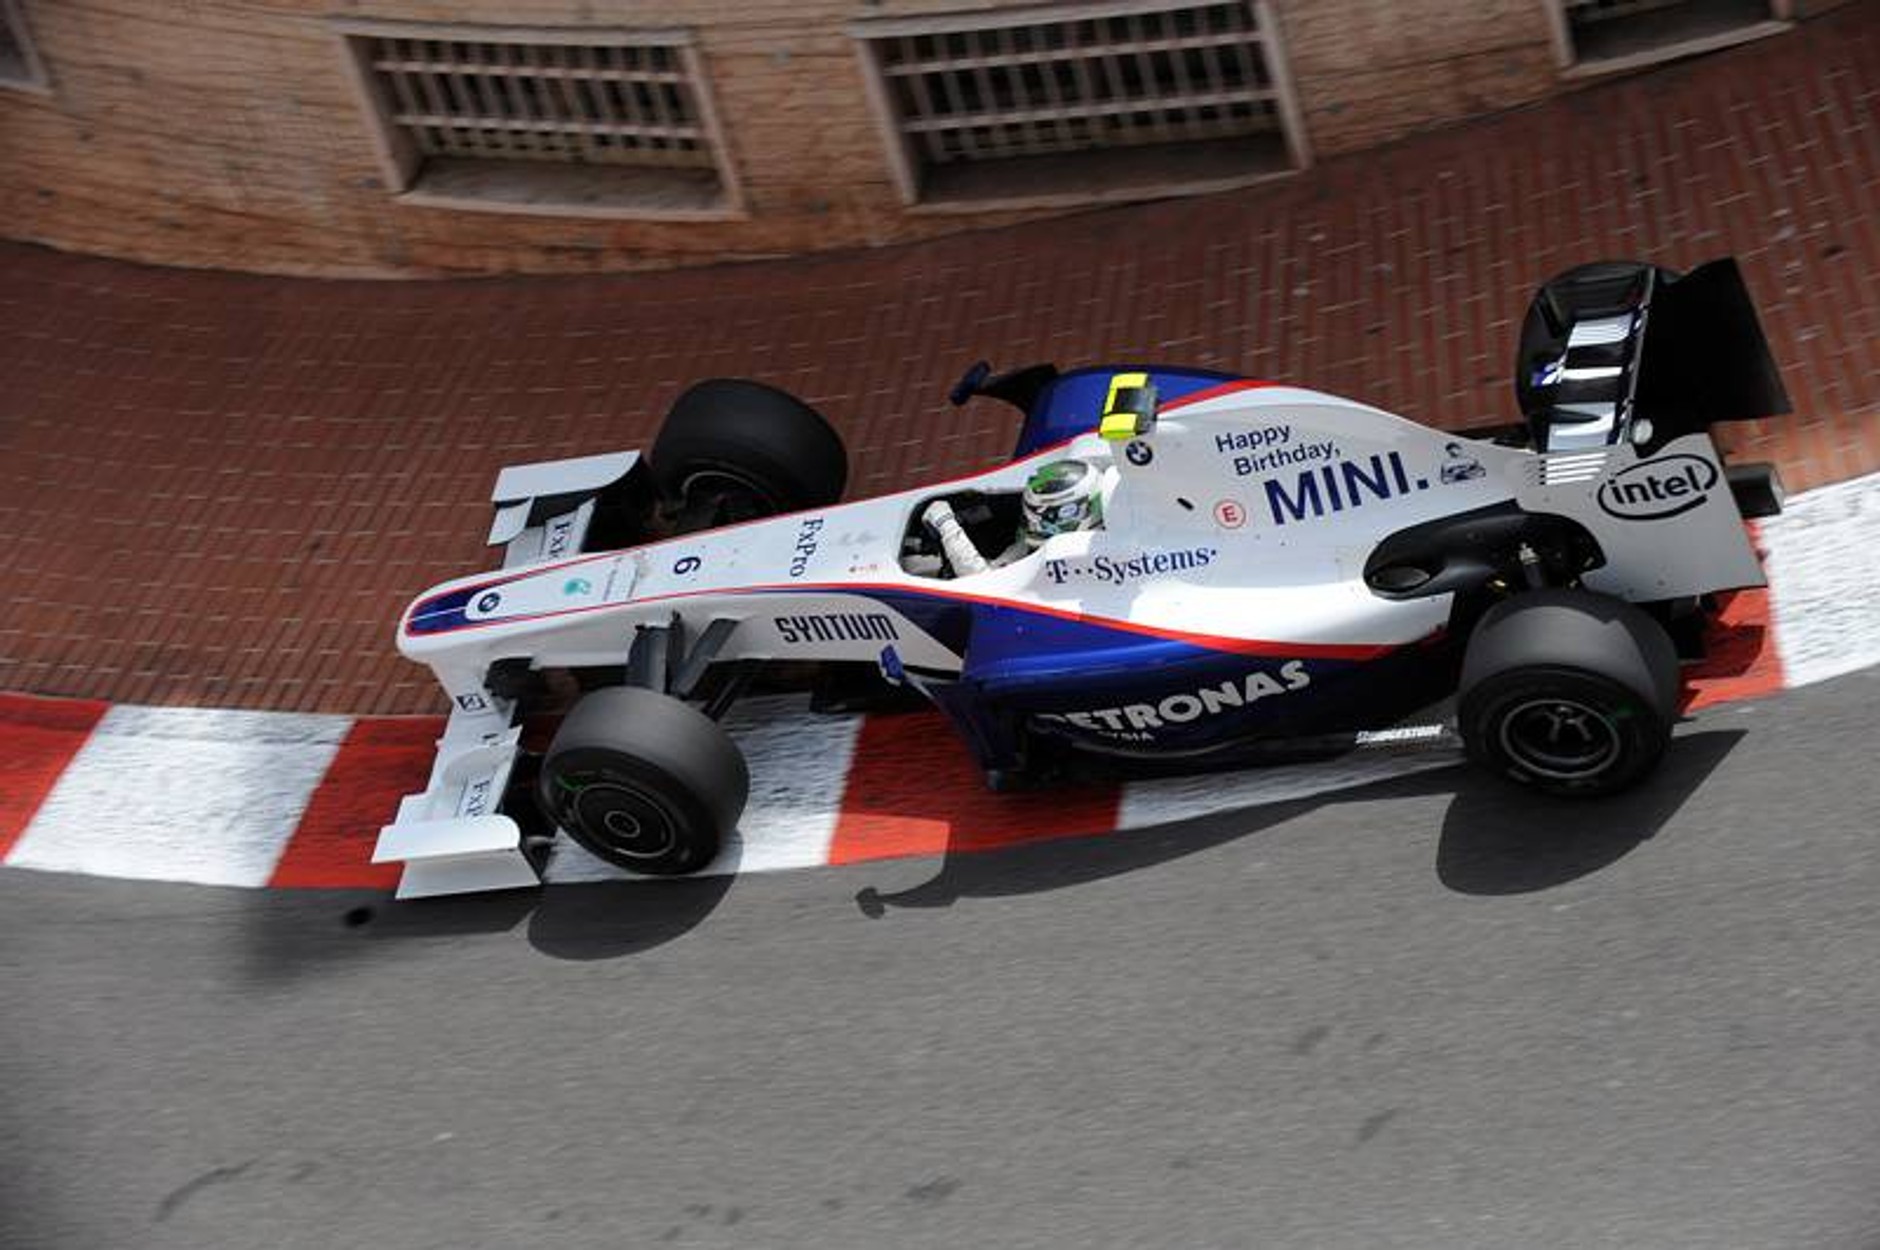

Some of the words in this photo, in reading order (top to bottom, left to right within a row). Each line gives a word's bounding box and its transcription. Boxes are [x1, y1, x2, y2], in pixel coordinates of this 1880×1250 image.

[1215, 425, 1291, 452] Happy
[1233, 440, 1341, 476] Birthday,
[1263, 451, 1430, 525] MINI.
[1608, 465, 1701, 504] intel
[1223, 505, 1237, 523] E
[789, 517, 824, 577] FxPro
[773, 613, 900, 643] SYNTIUM
